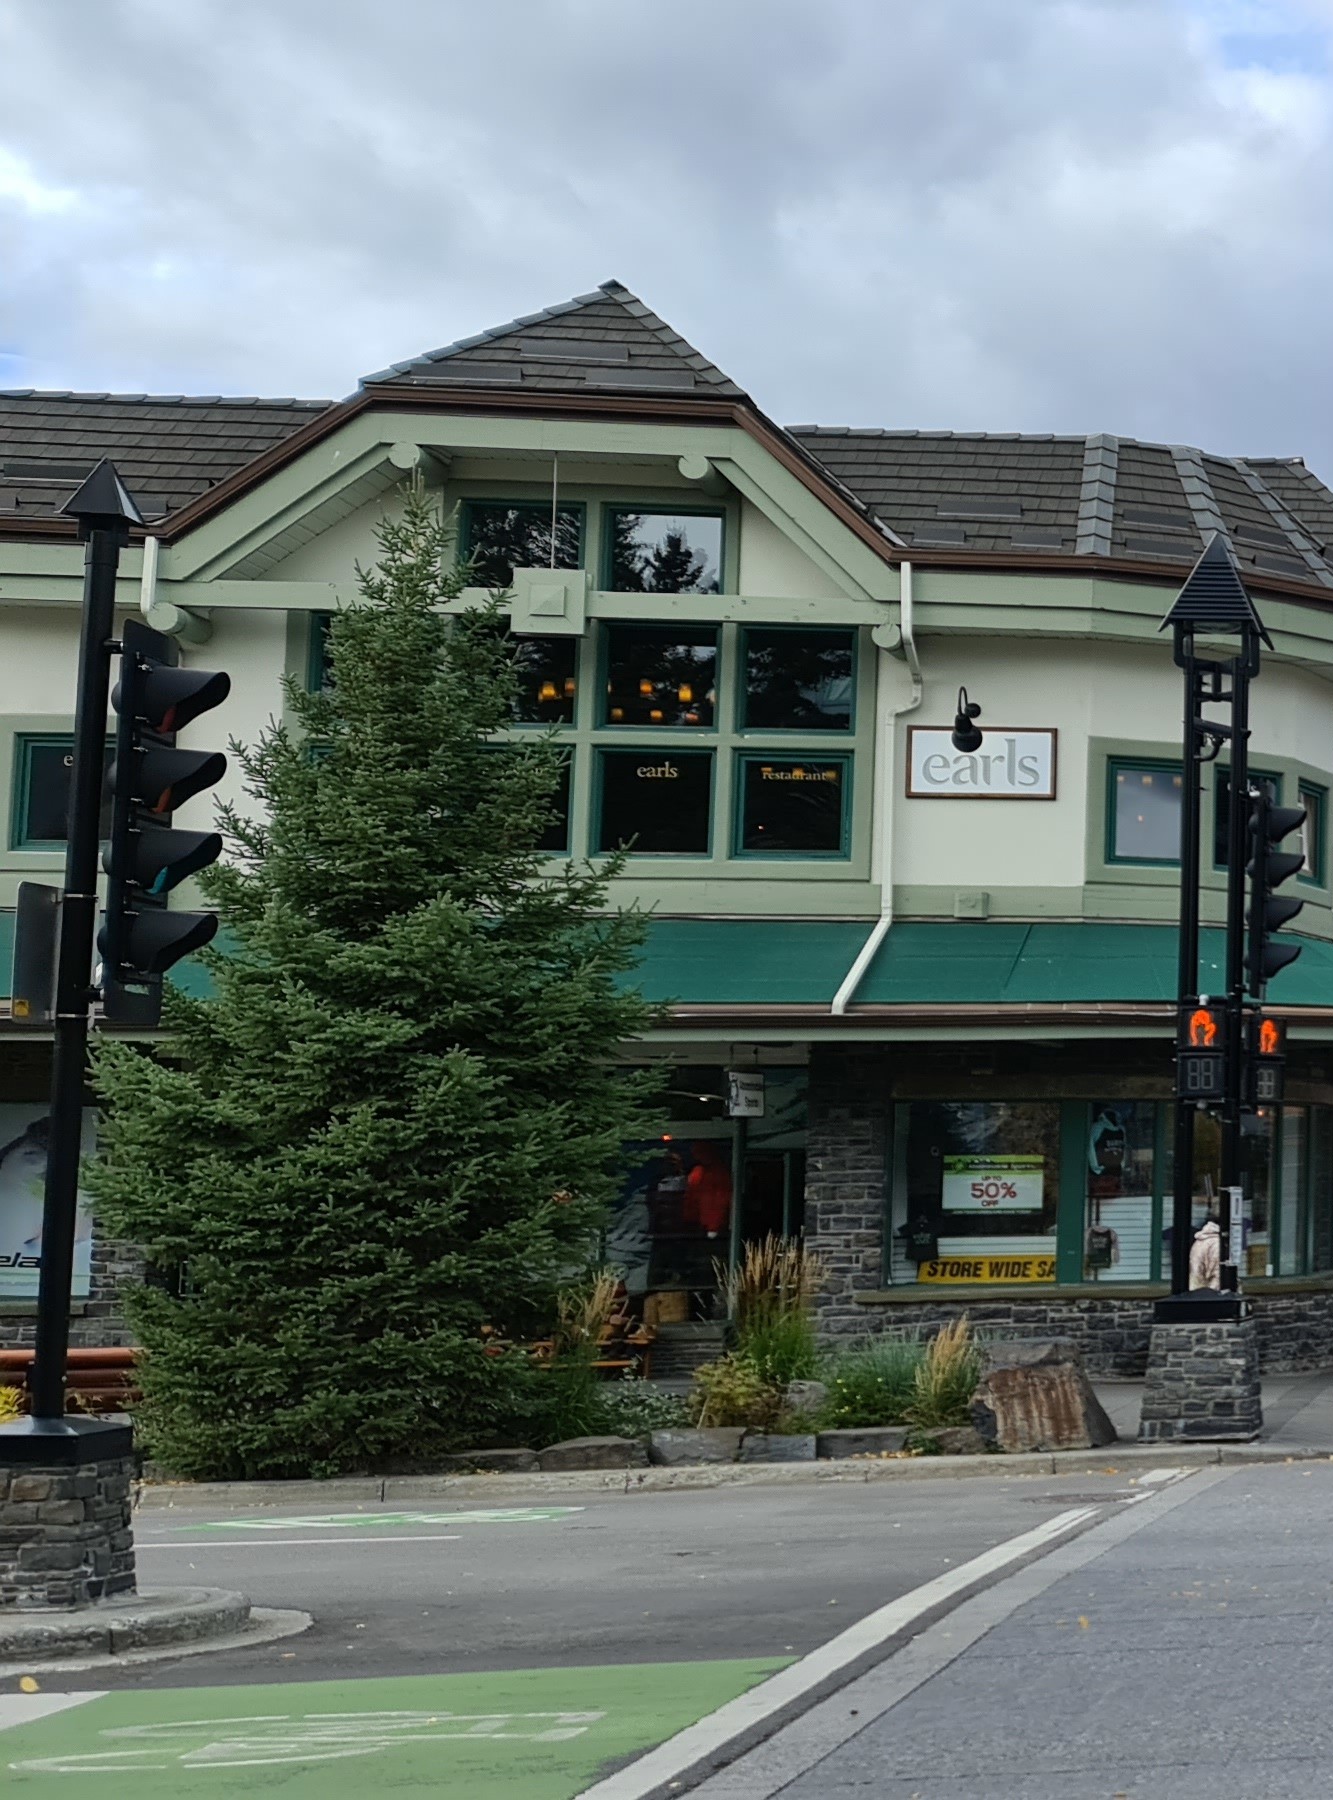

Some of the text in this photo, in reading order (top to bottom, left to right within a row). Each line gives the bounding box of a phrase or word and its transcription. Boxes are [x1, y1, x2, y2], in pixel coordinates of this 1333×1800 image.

[636, 761, 678, 778] earls
[921, 738, 1040, 786] earls
[970, 1182, 1017, 1199] 50%
[928, 1261, 983, 1278] STORE
[988, 1261, 1032, 1278] WIDE
